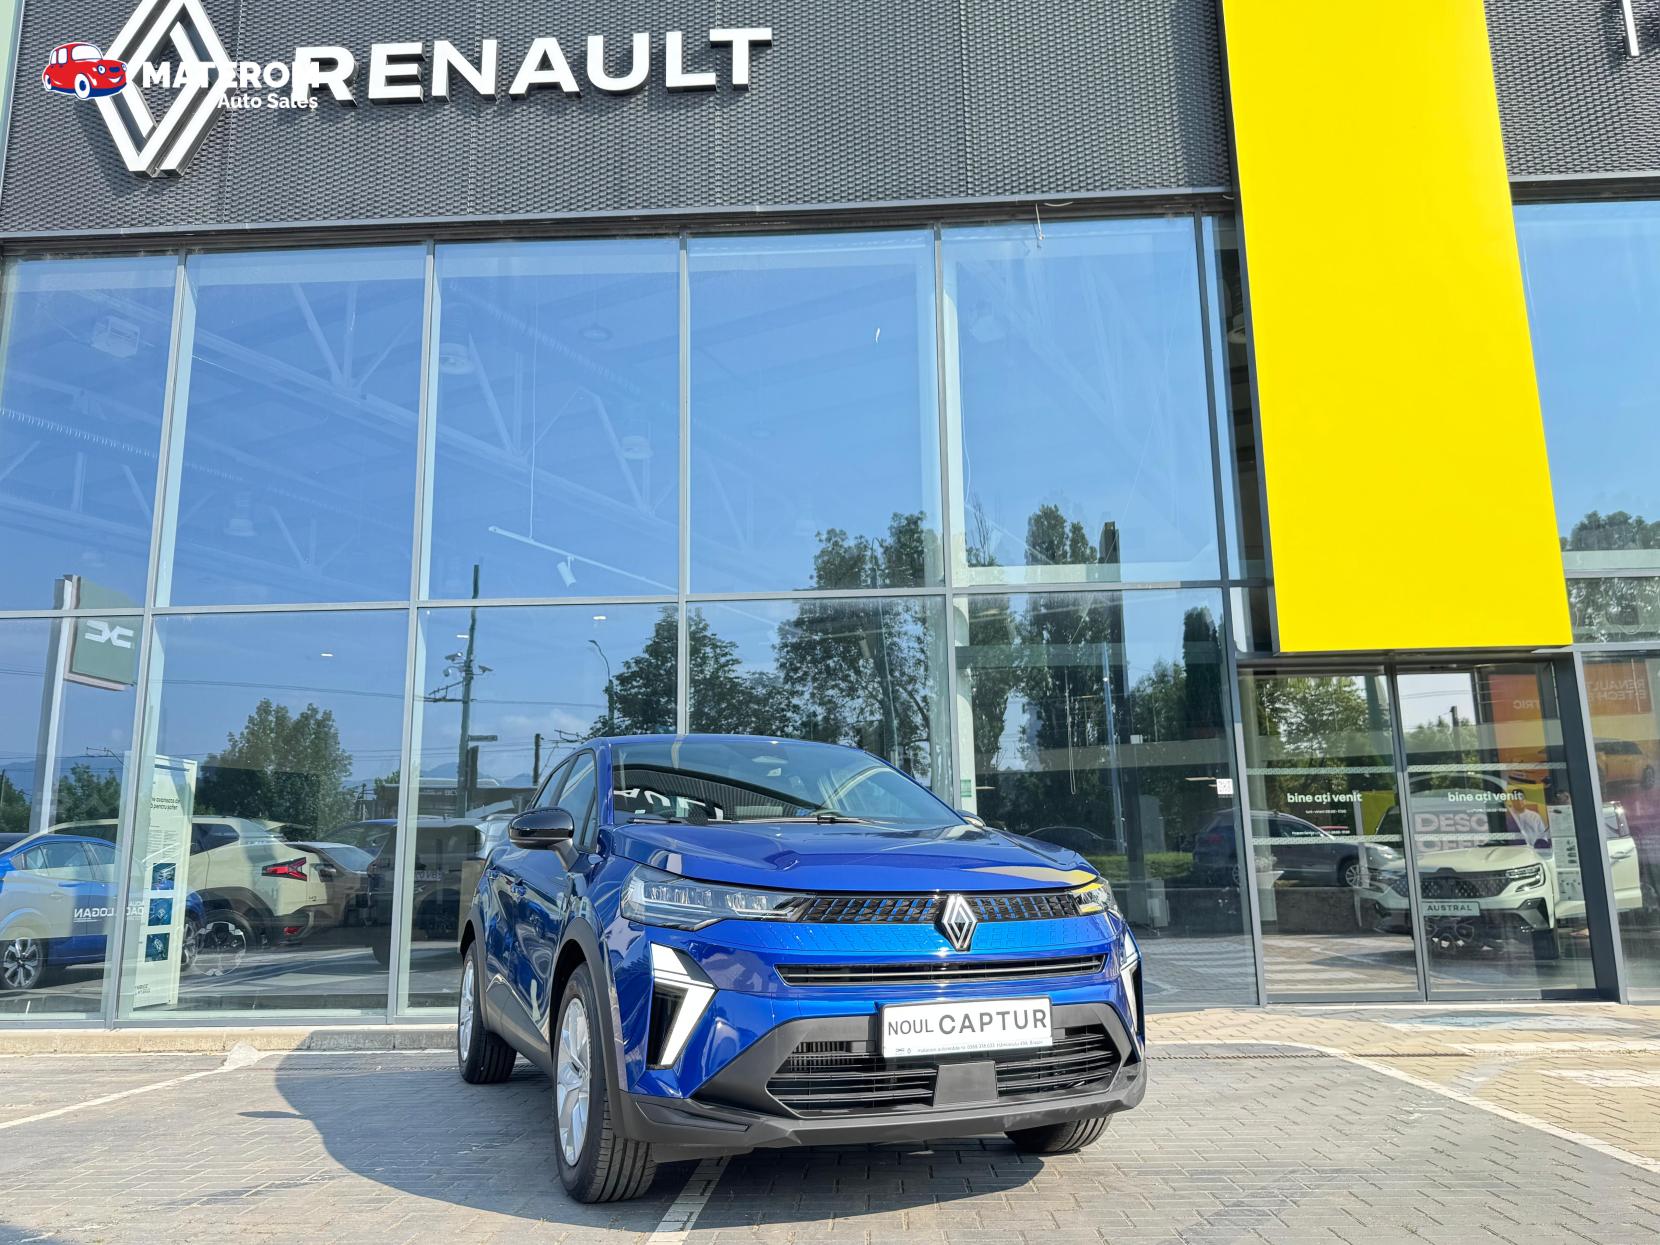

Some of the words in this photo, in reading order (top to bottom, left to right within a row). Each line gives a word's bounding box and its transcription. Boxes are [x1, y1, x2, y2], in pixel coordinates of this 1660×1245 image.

[292, 28, 773, 106] RENAULT
[1287, 792, 1313, 803] bine
[1332, 791, 1363, 803] venit
[1447, 792, 1473, 802] bine
[1492, 790, 1524, 801] venit
[1427, 904, 1473, 912] AUSTRAL
[888, 1019, 934, 1036] NOUL
[938, 1009, 1047, 1035] CAPTUR
